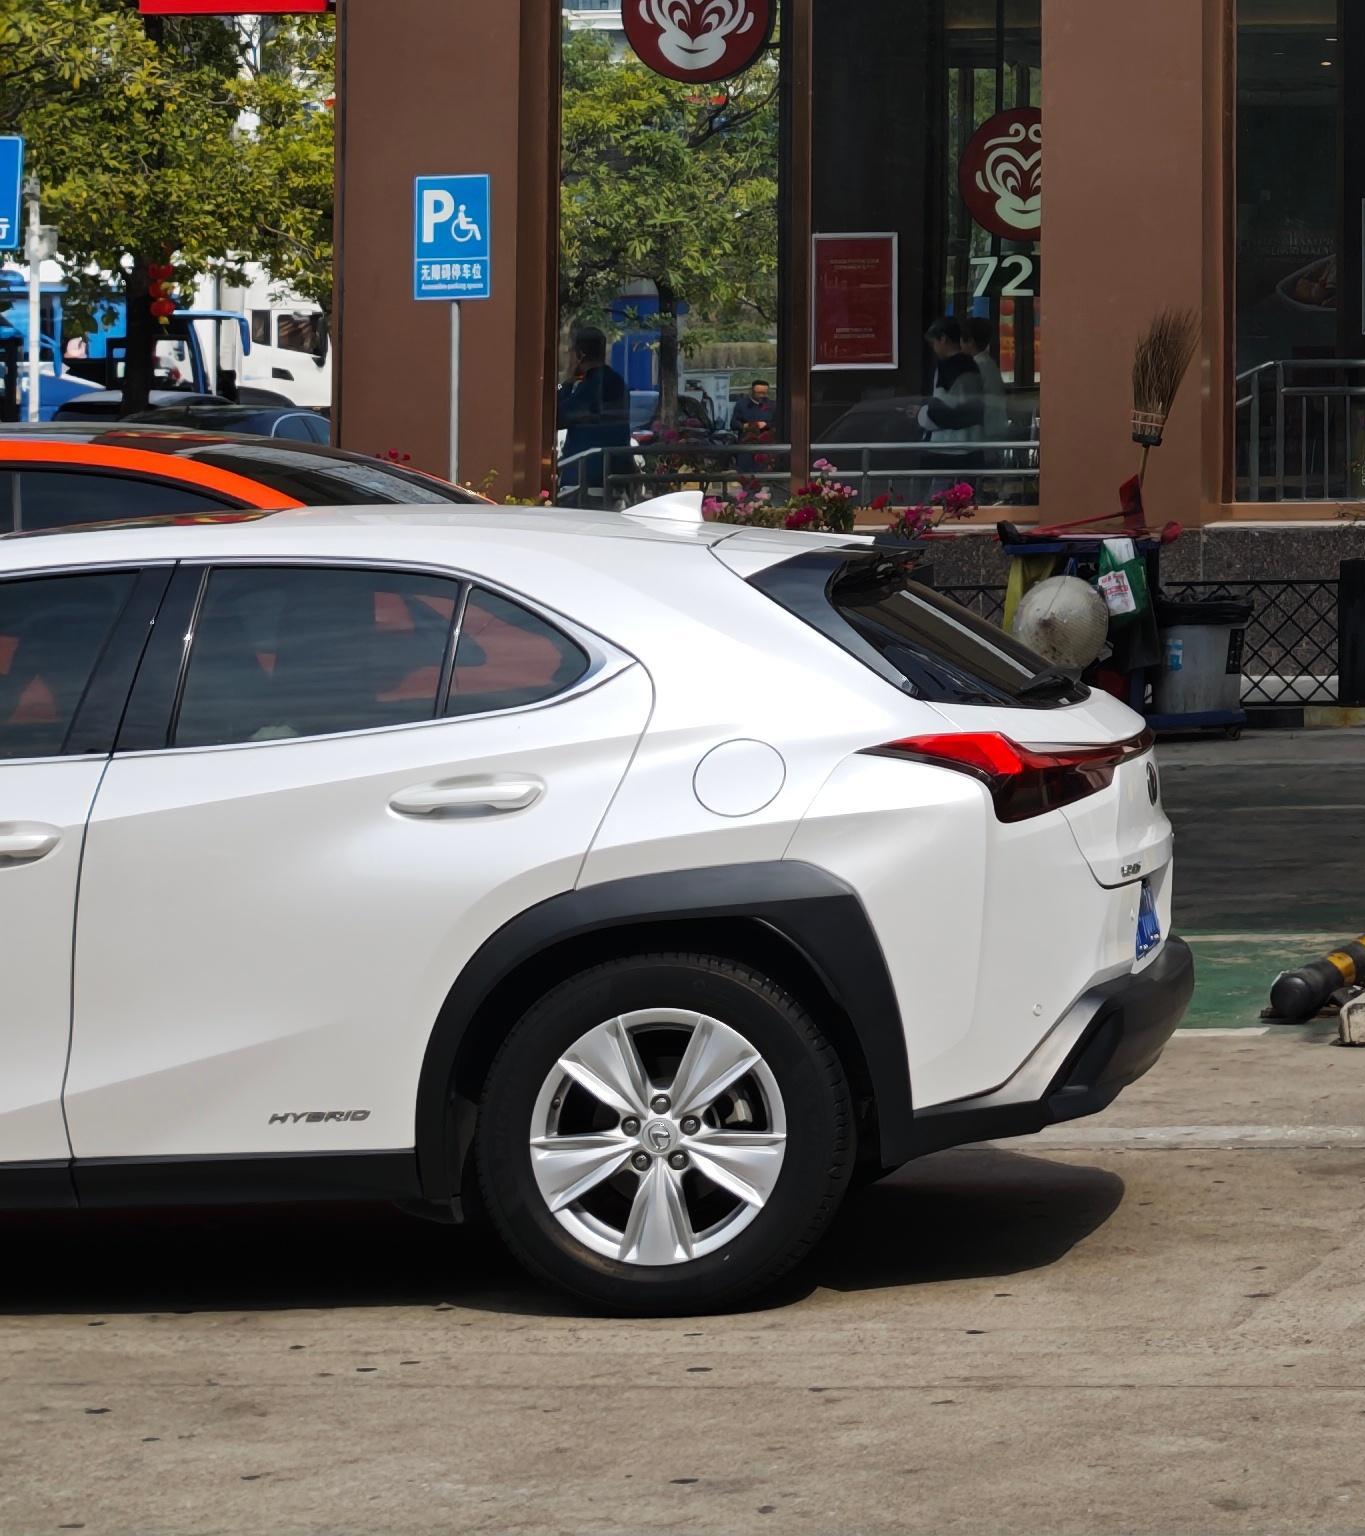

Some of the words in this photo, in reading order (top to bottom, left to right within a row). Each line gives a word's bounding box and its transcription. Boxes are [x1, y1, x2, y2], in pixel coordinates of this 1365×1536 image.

[422, 189, 455, 243] P
[969, 254, 1034, 297] 72
[268, 1110, 371, 1124] HYBRID
